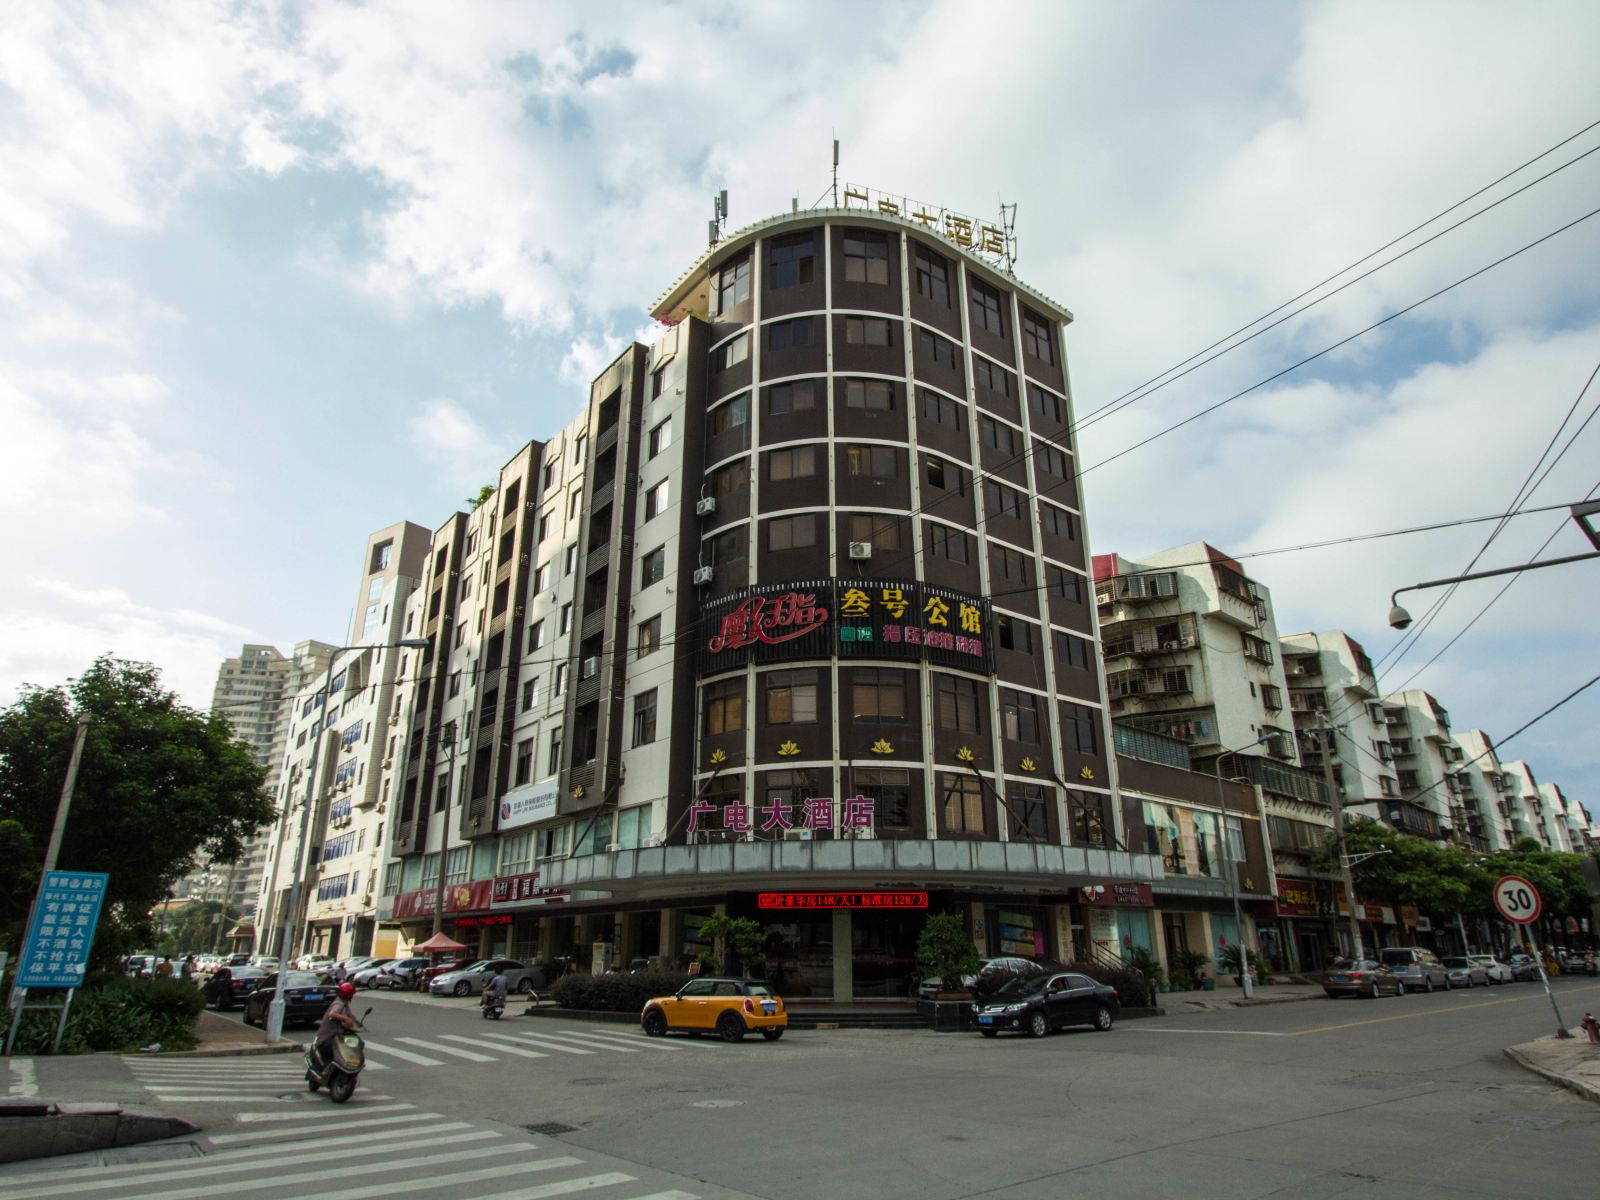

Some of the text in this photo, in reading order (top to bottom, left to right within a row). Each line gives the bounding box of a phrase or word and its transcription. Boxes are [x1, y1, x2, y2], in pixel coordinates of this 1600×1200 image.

[840, 588, 982, 634] 叁号公馆
[686, 796, 875, 833] 广电大酒店
[1503, 888, 1531, 912] 30
[47, 902, 92, 914] 有牌证
[42, 914, 90, 926] 戴头盔
[39, 926, 85, 938] 限两人
[36, 938, 83, 950] 不酒驾
[33, 950, 80, 962] 不抢行
[28, 962, 77, 974] 保平安
